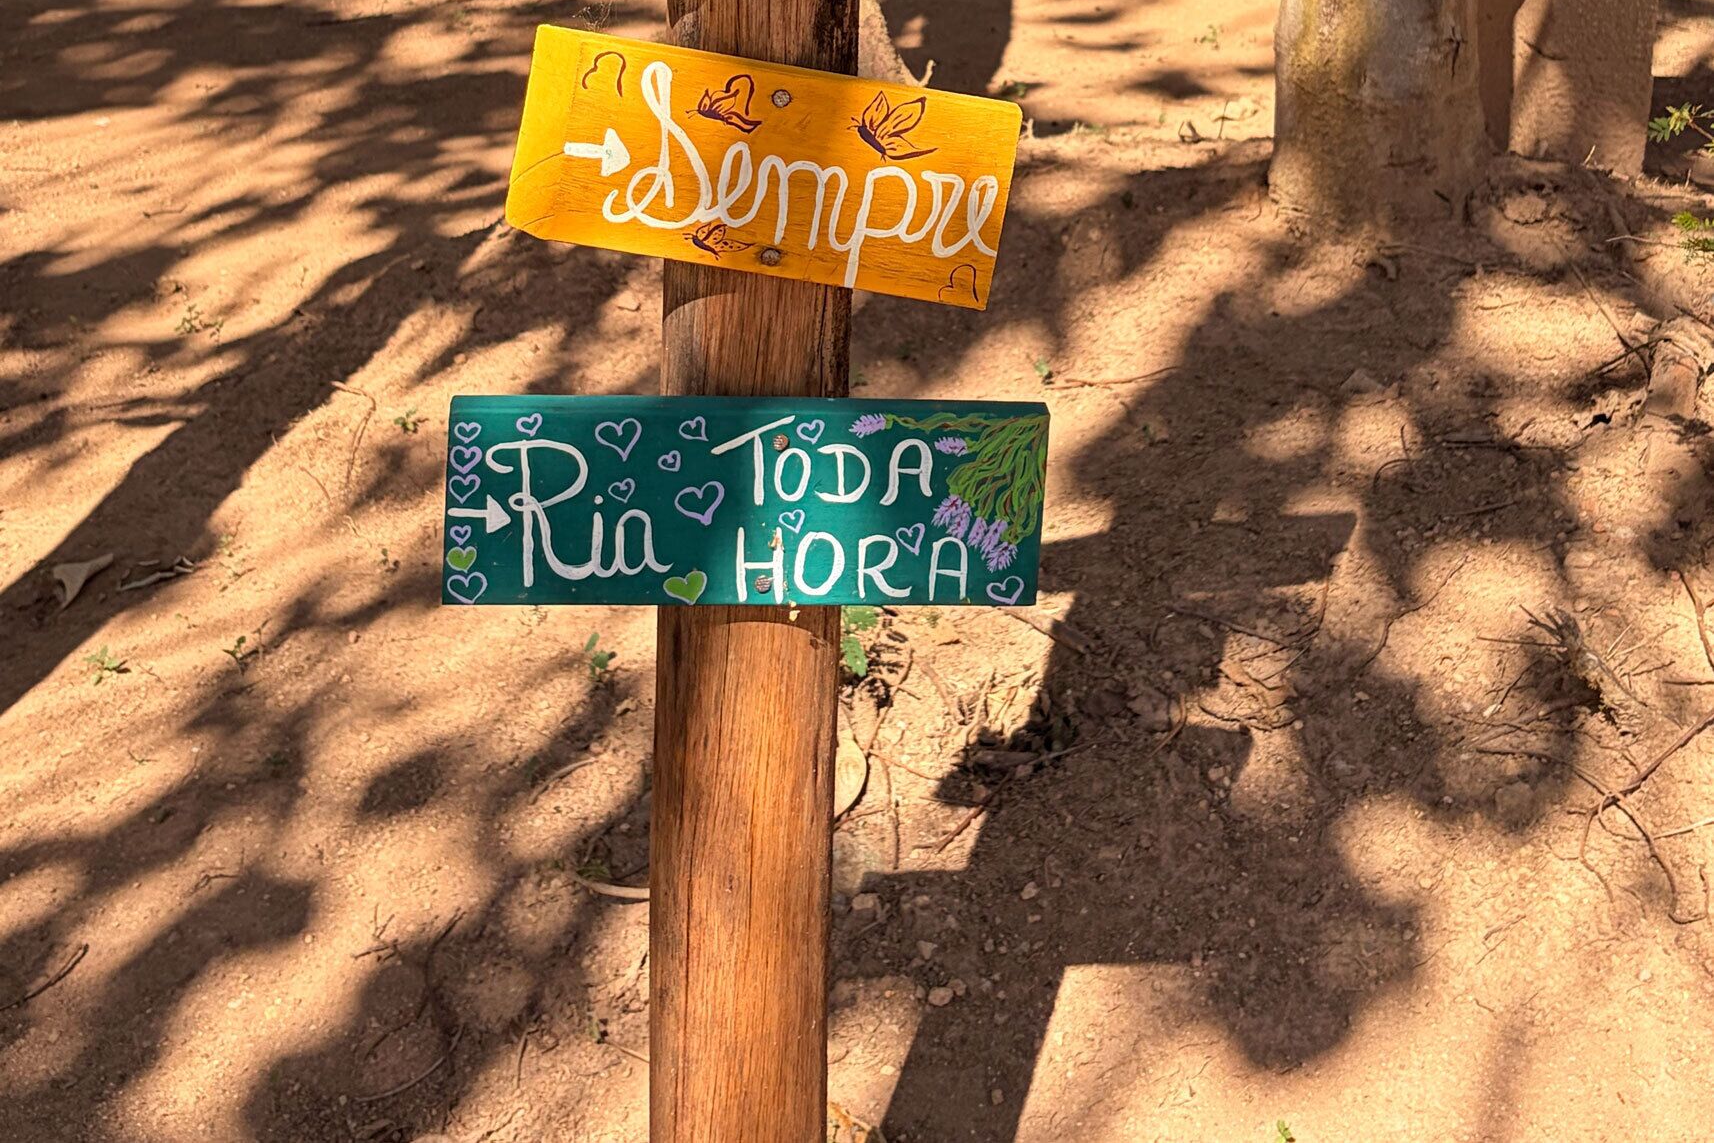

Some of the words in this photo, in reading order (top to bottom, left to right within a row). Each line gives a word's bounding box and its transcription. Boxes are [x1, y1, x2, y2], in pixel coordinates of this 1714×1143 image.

[601, 60, 999, 289] Sempre
[485, 438, 674, 588] Ria
[710, 414, 934, 507] TODA
[735, 525, 970, 605] HORA
